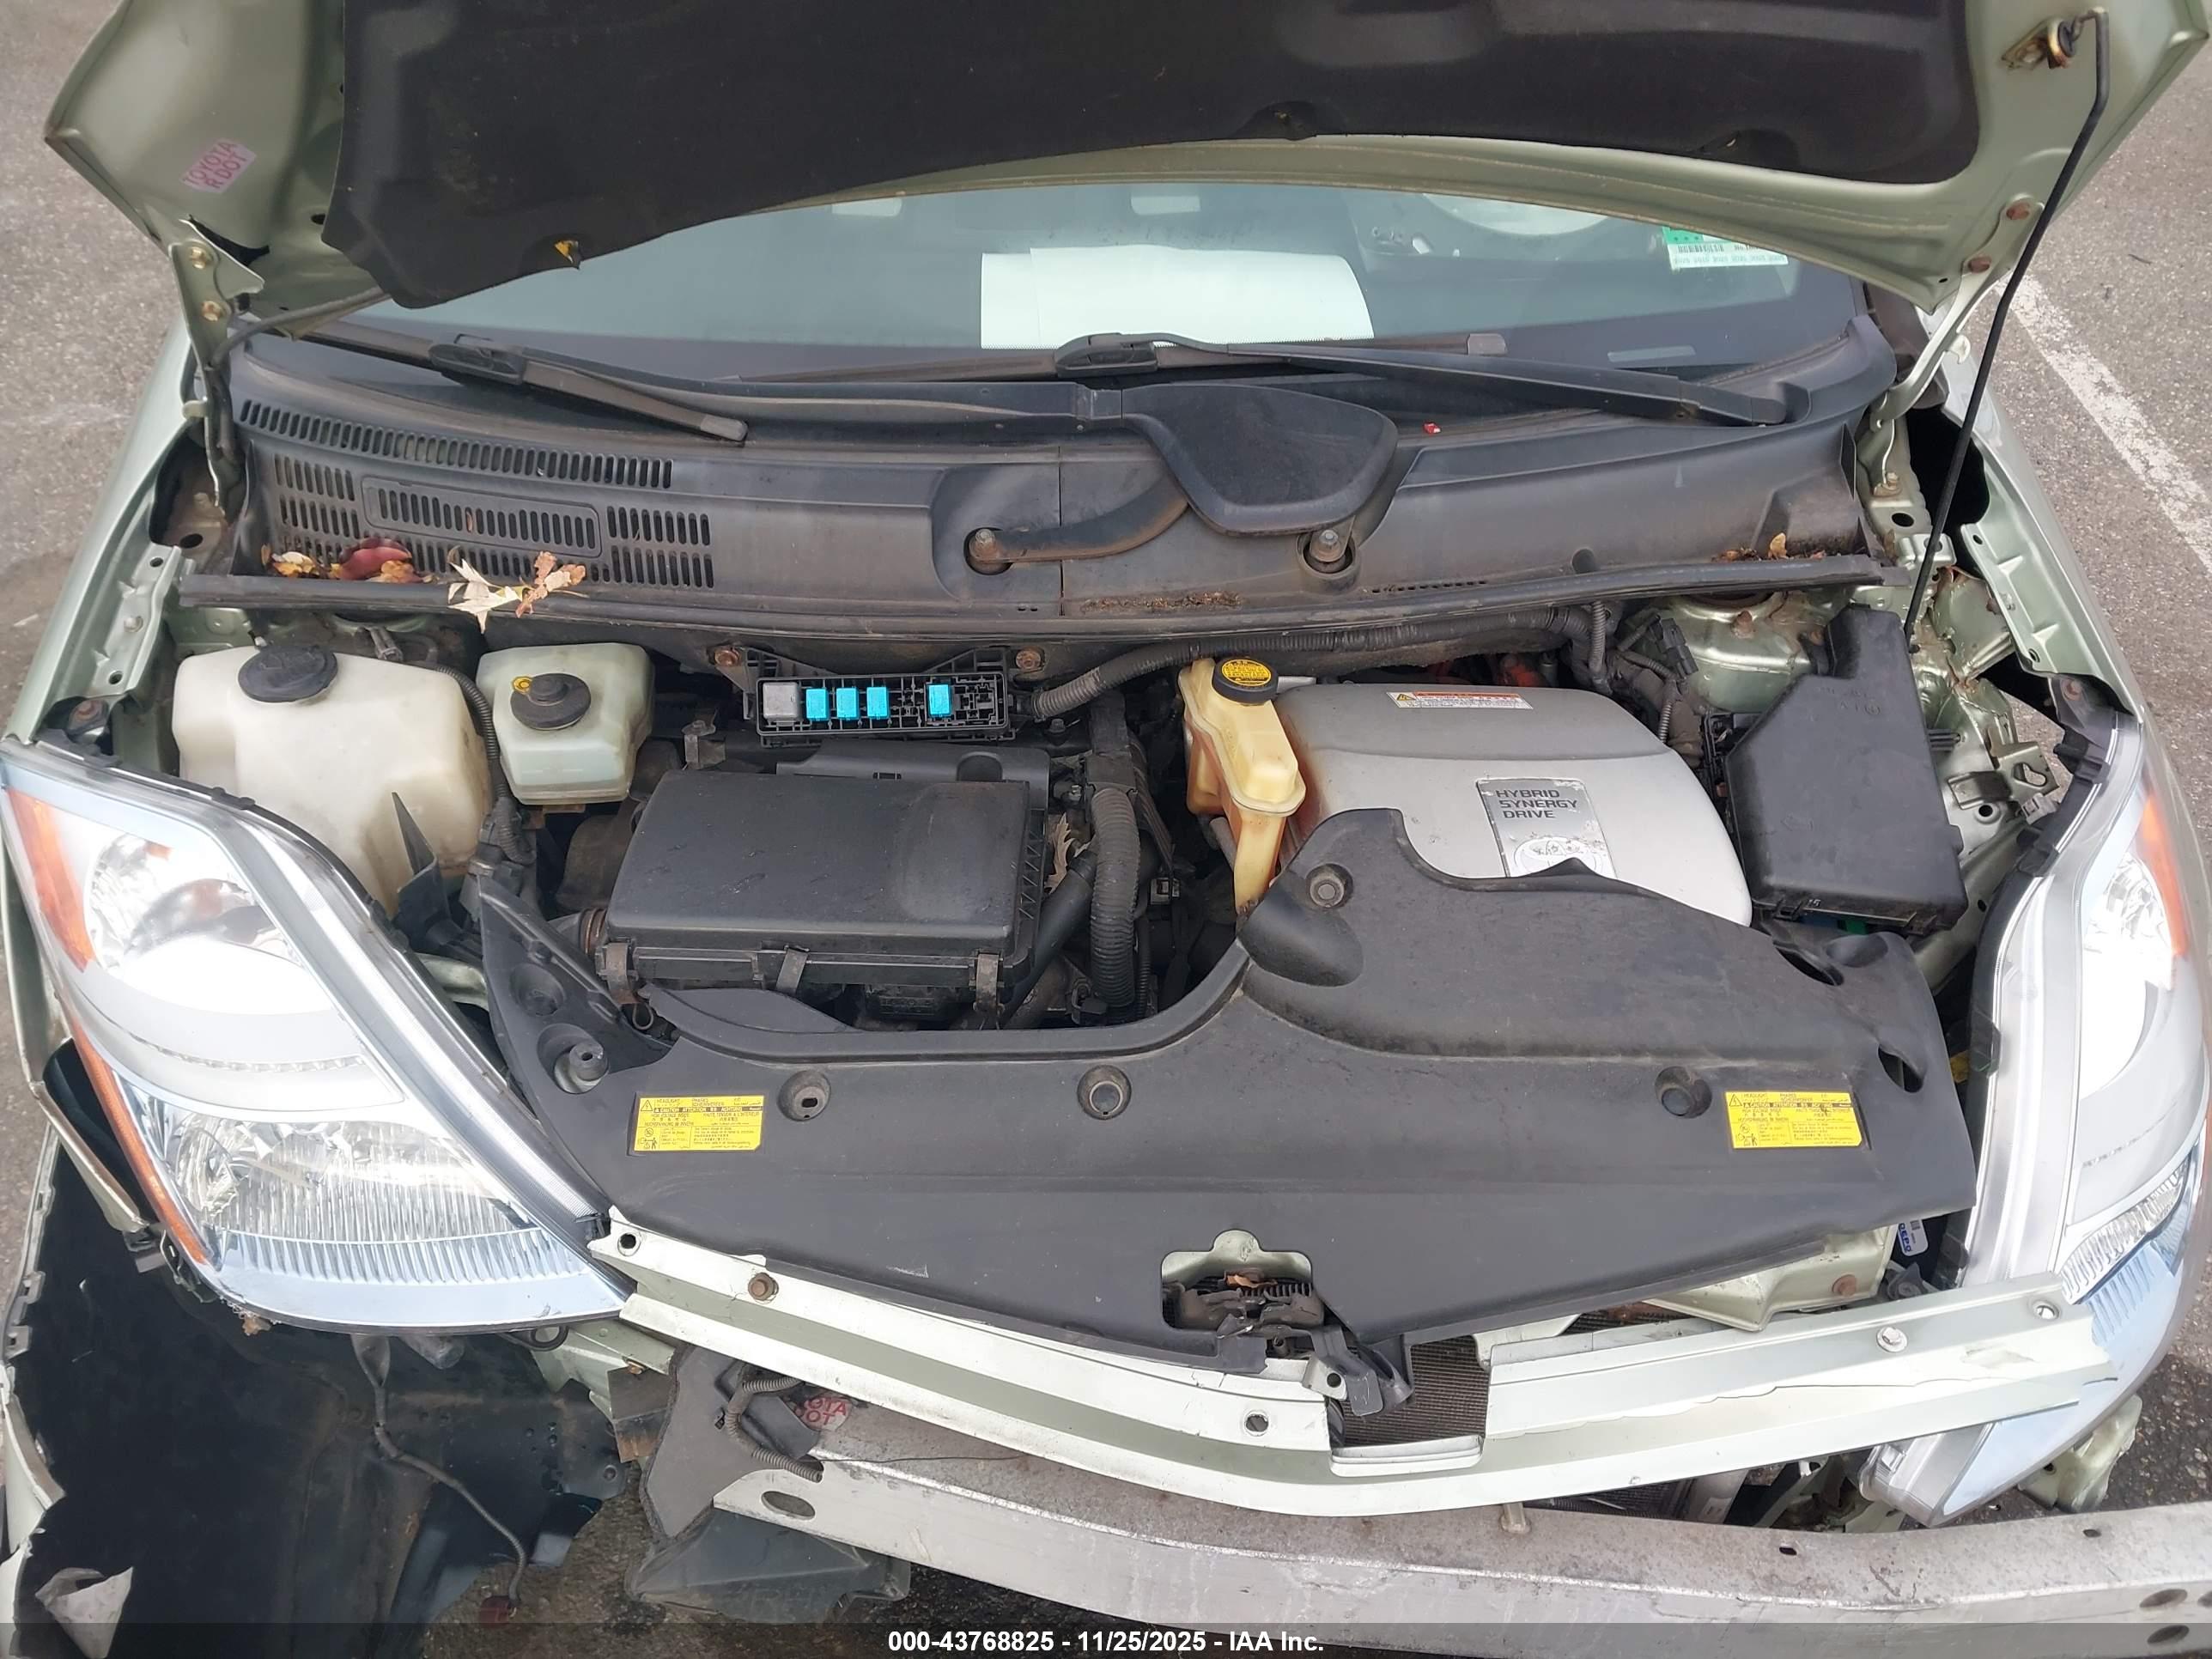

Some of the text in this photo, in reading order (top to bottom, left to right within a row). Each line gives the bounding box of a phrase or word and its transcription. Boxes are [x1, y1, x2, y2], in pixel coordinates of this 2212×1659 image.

[181, 142, 238, 185] TOYOTA
[214, 151, 246, 179] DOT
[1496, 789, 1560, 798] HYBRID
[1498, 799, 1577, 808] SYNERGY
[1503, 810, 1556, 818] DRIVE
[1899, 1222, 1911, 1253] DEPO
